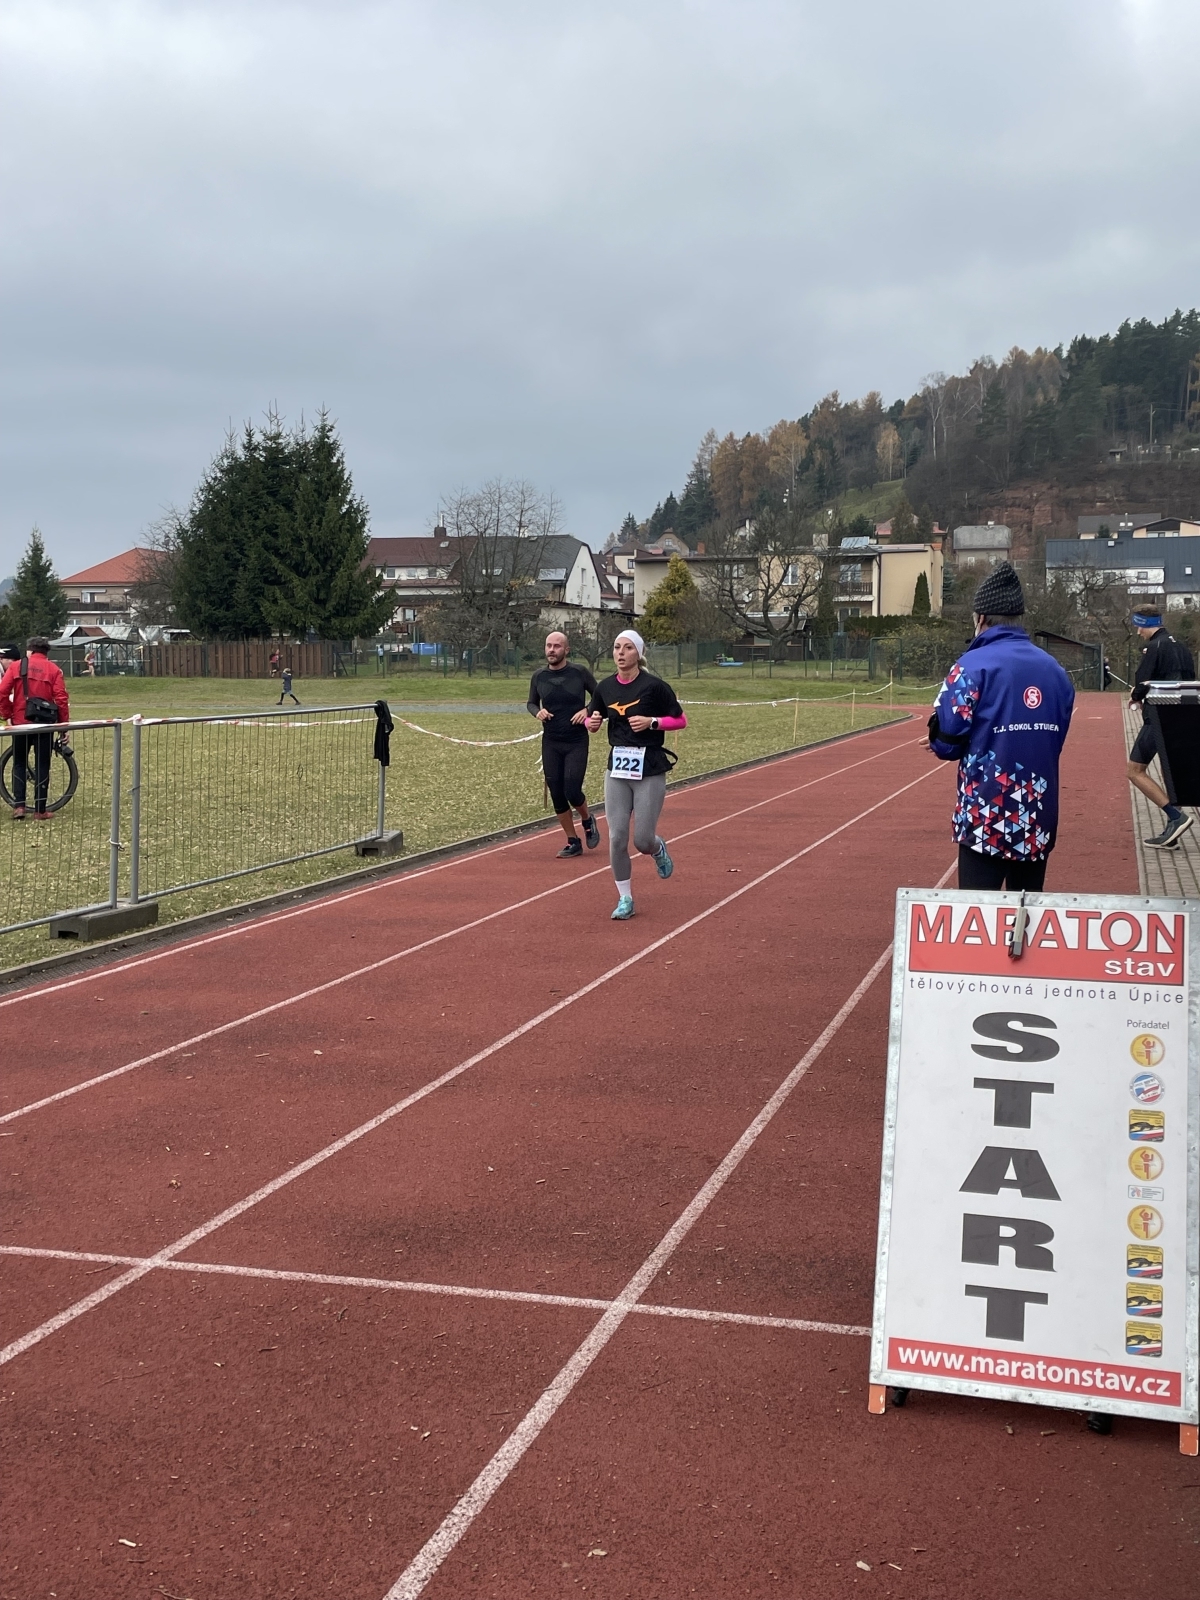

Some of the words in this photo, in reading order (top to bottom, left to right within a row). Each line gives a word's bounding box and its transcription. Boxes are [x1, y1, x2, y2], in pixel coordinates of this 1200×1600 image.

[1008, 723, 1032, 732] SOKOL
[615, 757, 640, 772] 222
[1104, 957, 1176, 978] stav
[910, 977, 1034, 996] tělovýchovná
[1044, 984, 1117, 1001] jednota
[1129, 988, 1184, 1004] Úpice
[1126, 1019, 1170, 1030] Pořadatel
[959, 1011, 1063, 1342] START
[897, 1346, 1171, 1397] www.maratonstav.cz
